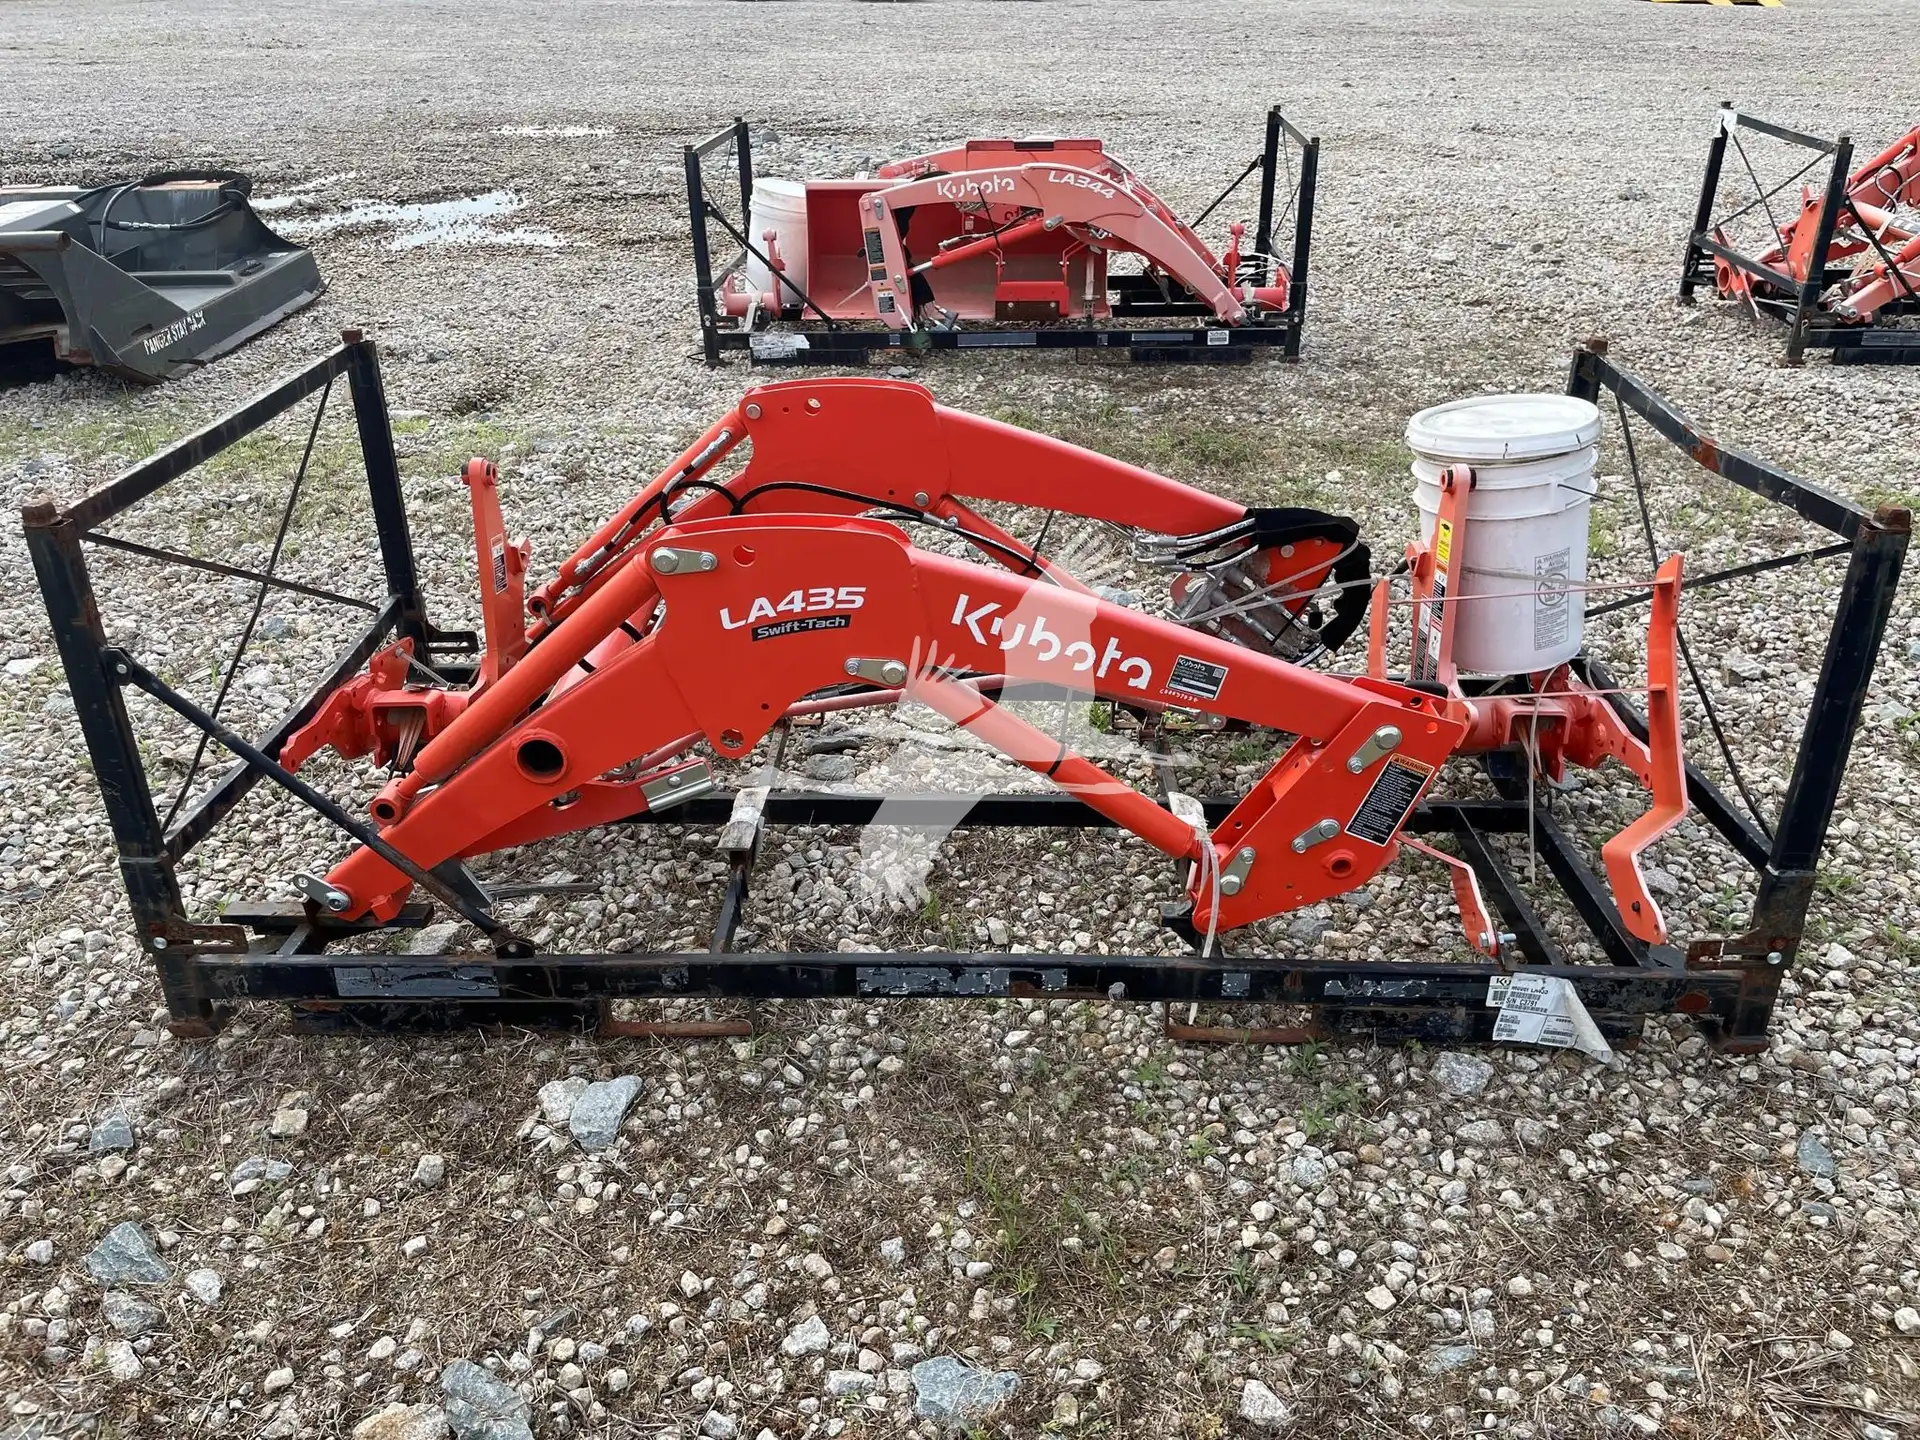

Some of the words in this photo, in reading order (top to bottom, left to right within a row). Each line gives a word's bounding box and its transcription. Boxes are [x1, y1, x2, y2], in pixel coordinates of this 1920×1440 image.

[936, 174, 1015, 199] Kubota
[1047, 170, 1117, 199] LA344
[170, 318, 189, 342] STAY
[719, 586, 867, 631] LA435
[756, 616, 846, 639] Swift-Tach
[951, 593, 1153, 690] Kubota
[1178, 657, 1206, 671] Kubota
[1398, 758, 1430, 774] WARNING
